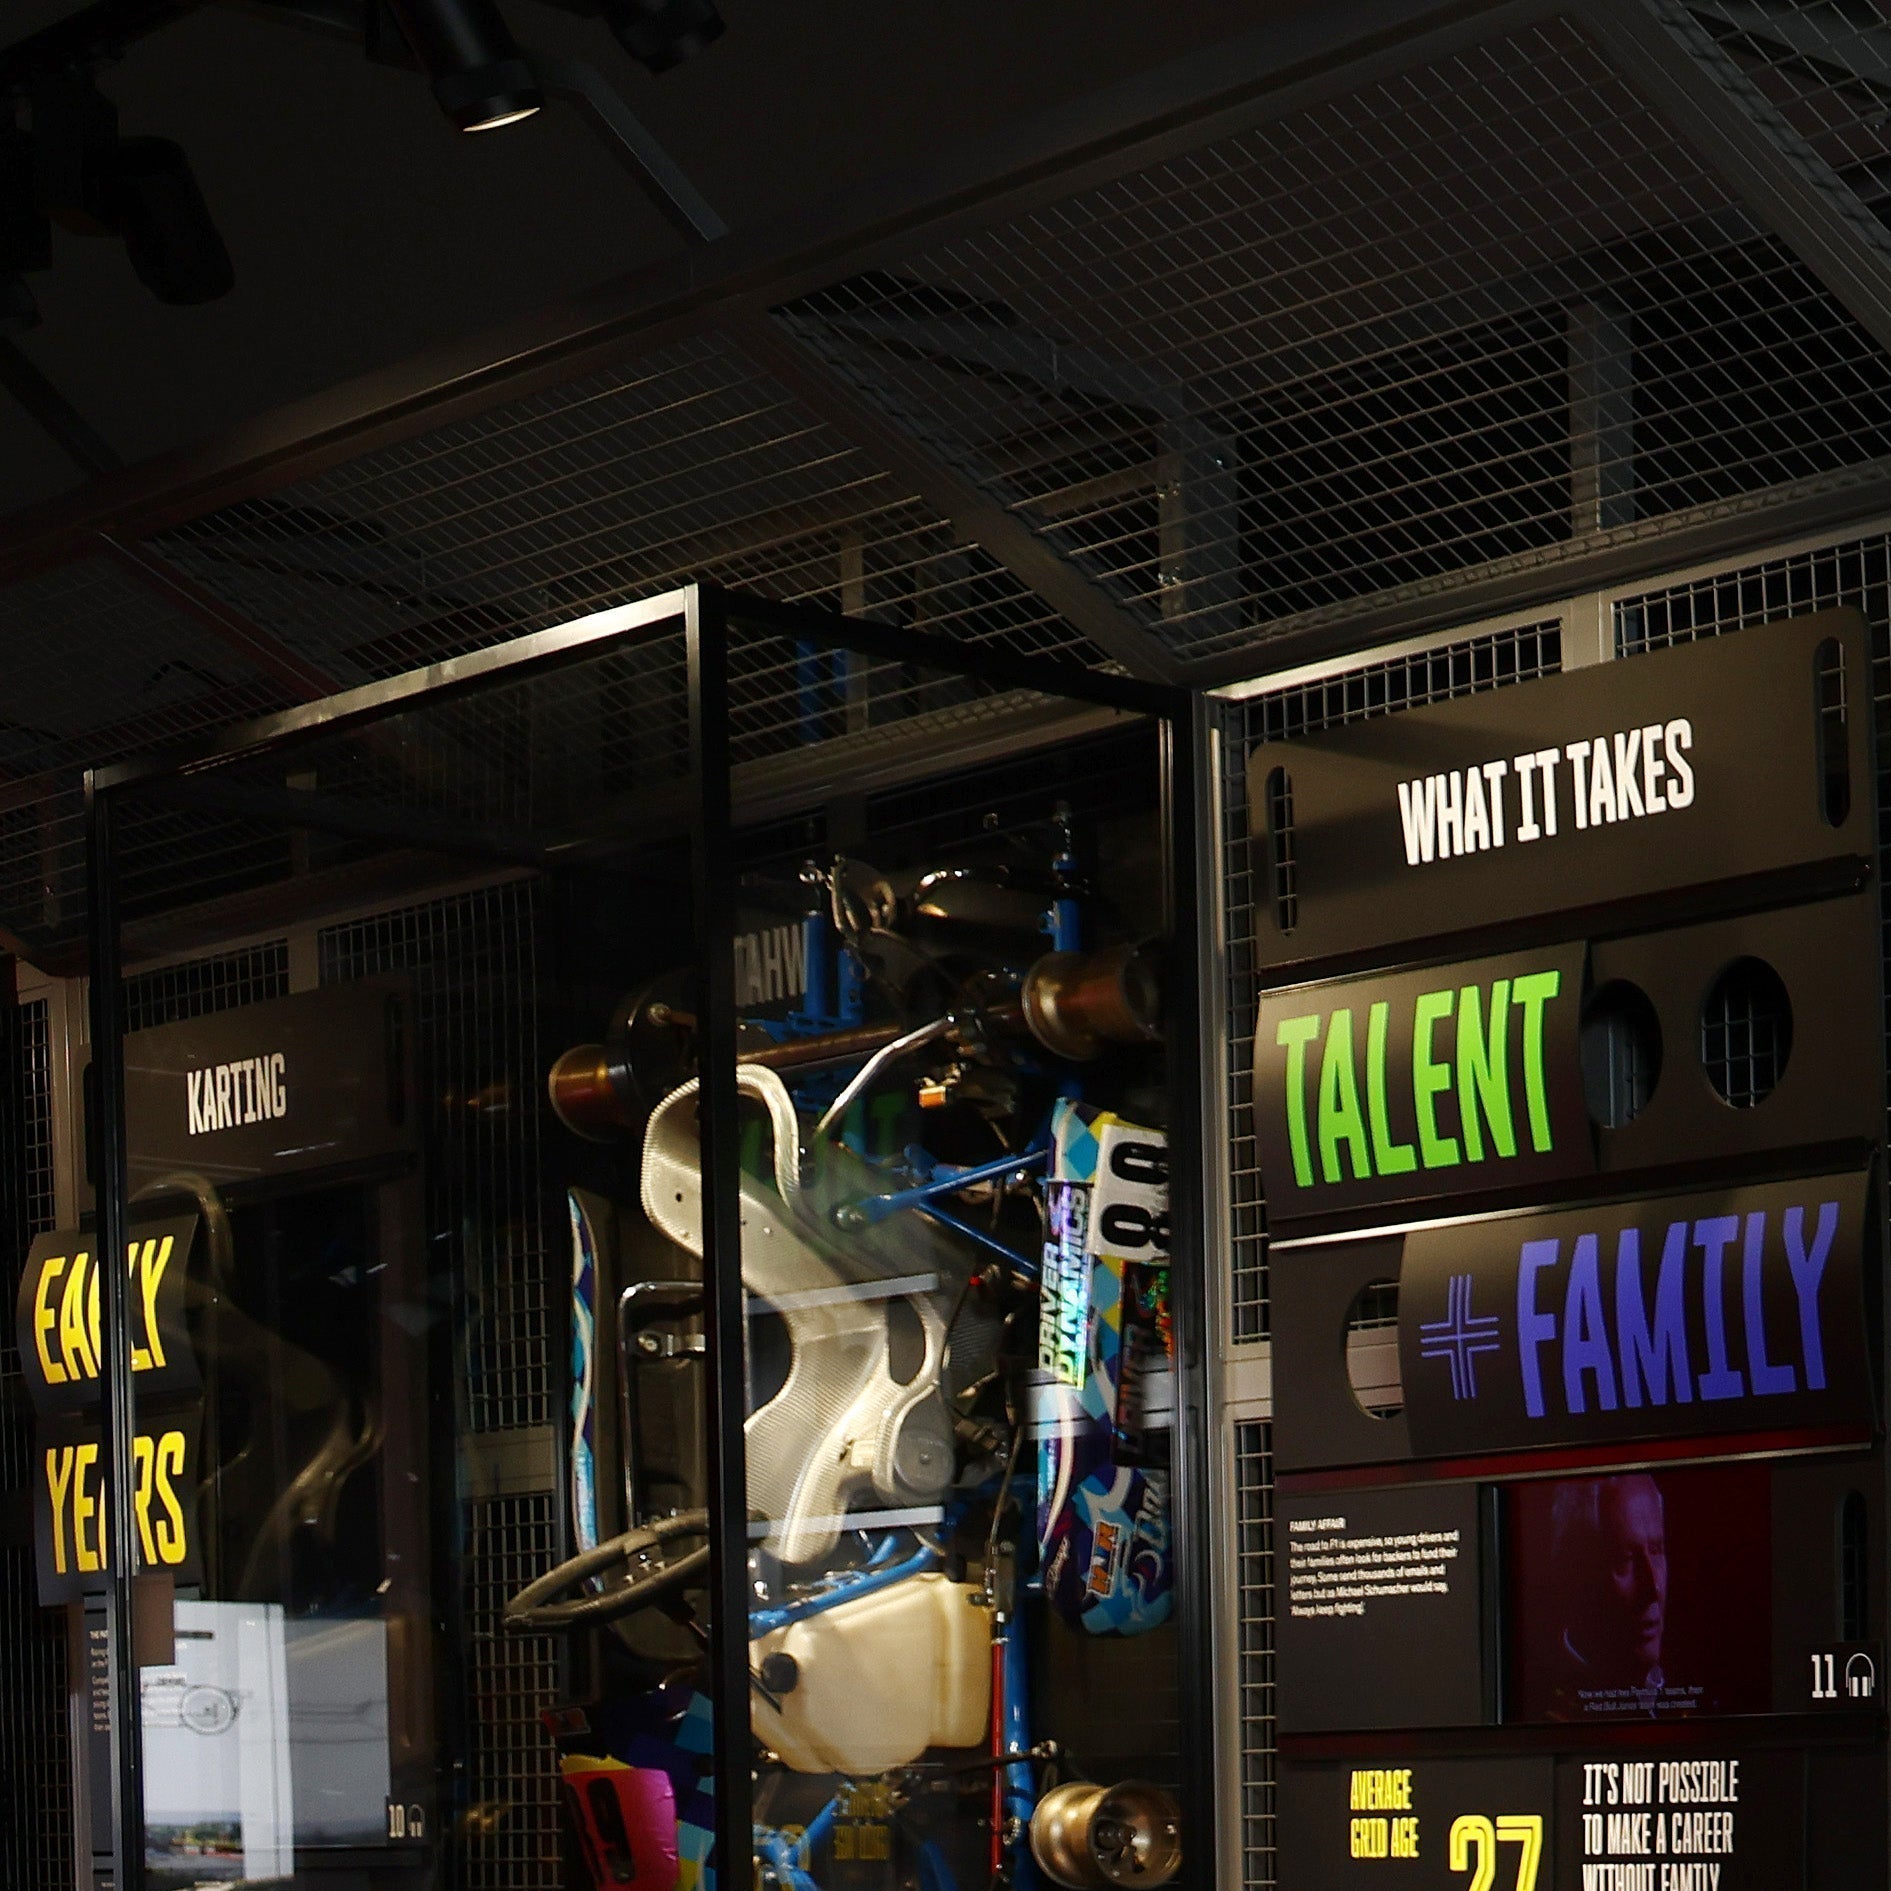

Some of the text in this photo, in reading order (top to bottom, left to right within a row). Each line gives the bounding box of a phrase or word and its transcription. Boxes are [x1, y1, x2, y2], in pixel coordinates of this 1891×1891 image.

[1398, 718, 1694, 866] WHAT IT TAKES
[188, 1053, 286, 1135] KARTING
[1275, 969, 1561, 1188] TALENT
[34, 1236, 174, 1385] EALY
[1039, 1241, 1058, 1371] DRIVER
[1056, 1186, 1089, 1387] DYNAMICS
[1516, 1201, 1840, 1417] FAMILY
[46, 1431, 187, 1574] YERS
[1289, 1520, 1316, 1532] FAMILY
[1811, 1655, 1837, 1698] 11
[389, 1805, 405, 1838] 10
[1350, 1769, 1412, 1810] AVERAGE
[1583, 1761, 1739, 1806] IT'S NOT POSSIBLE
[1350, 1817, 1420, 1858] GRID AGE
[1583, 1812, 1733, 1855] TO MAKE A CAREER
